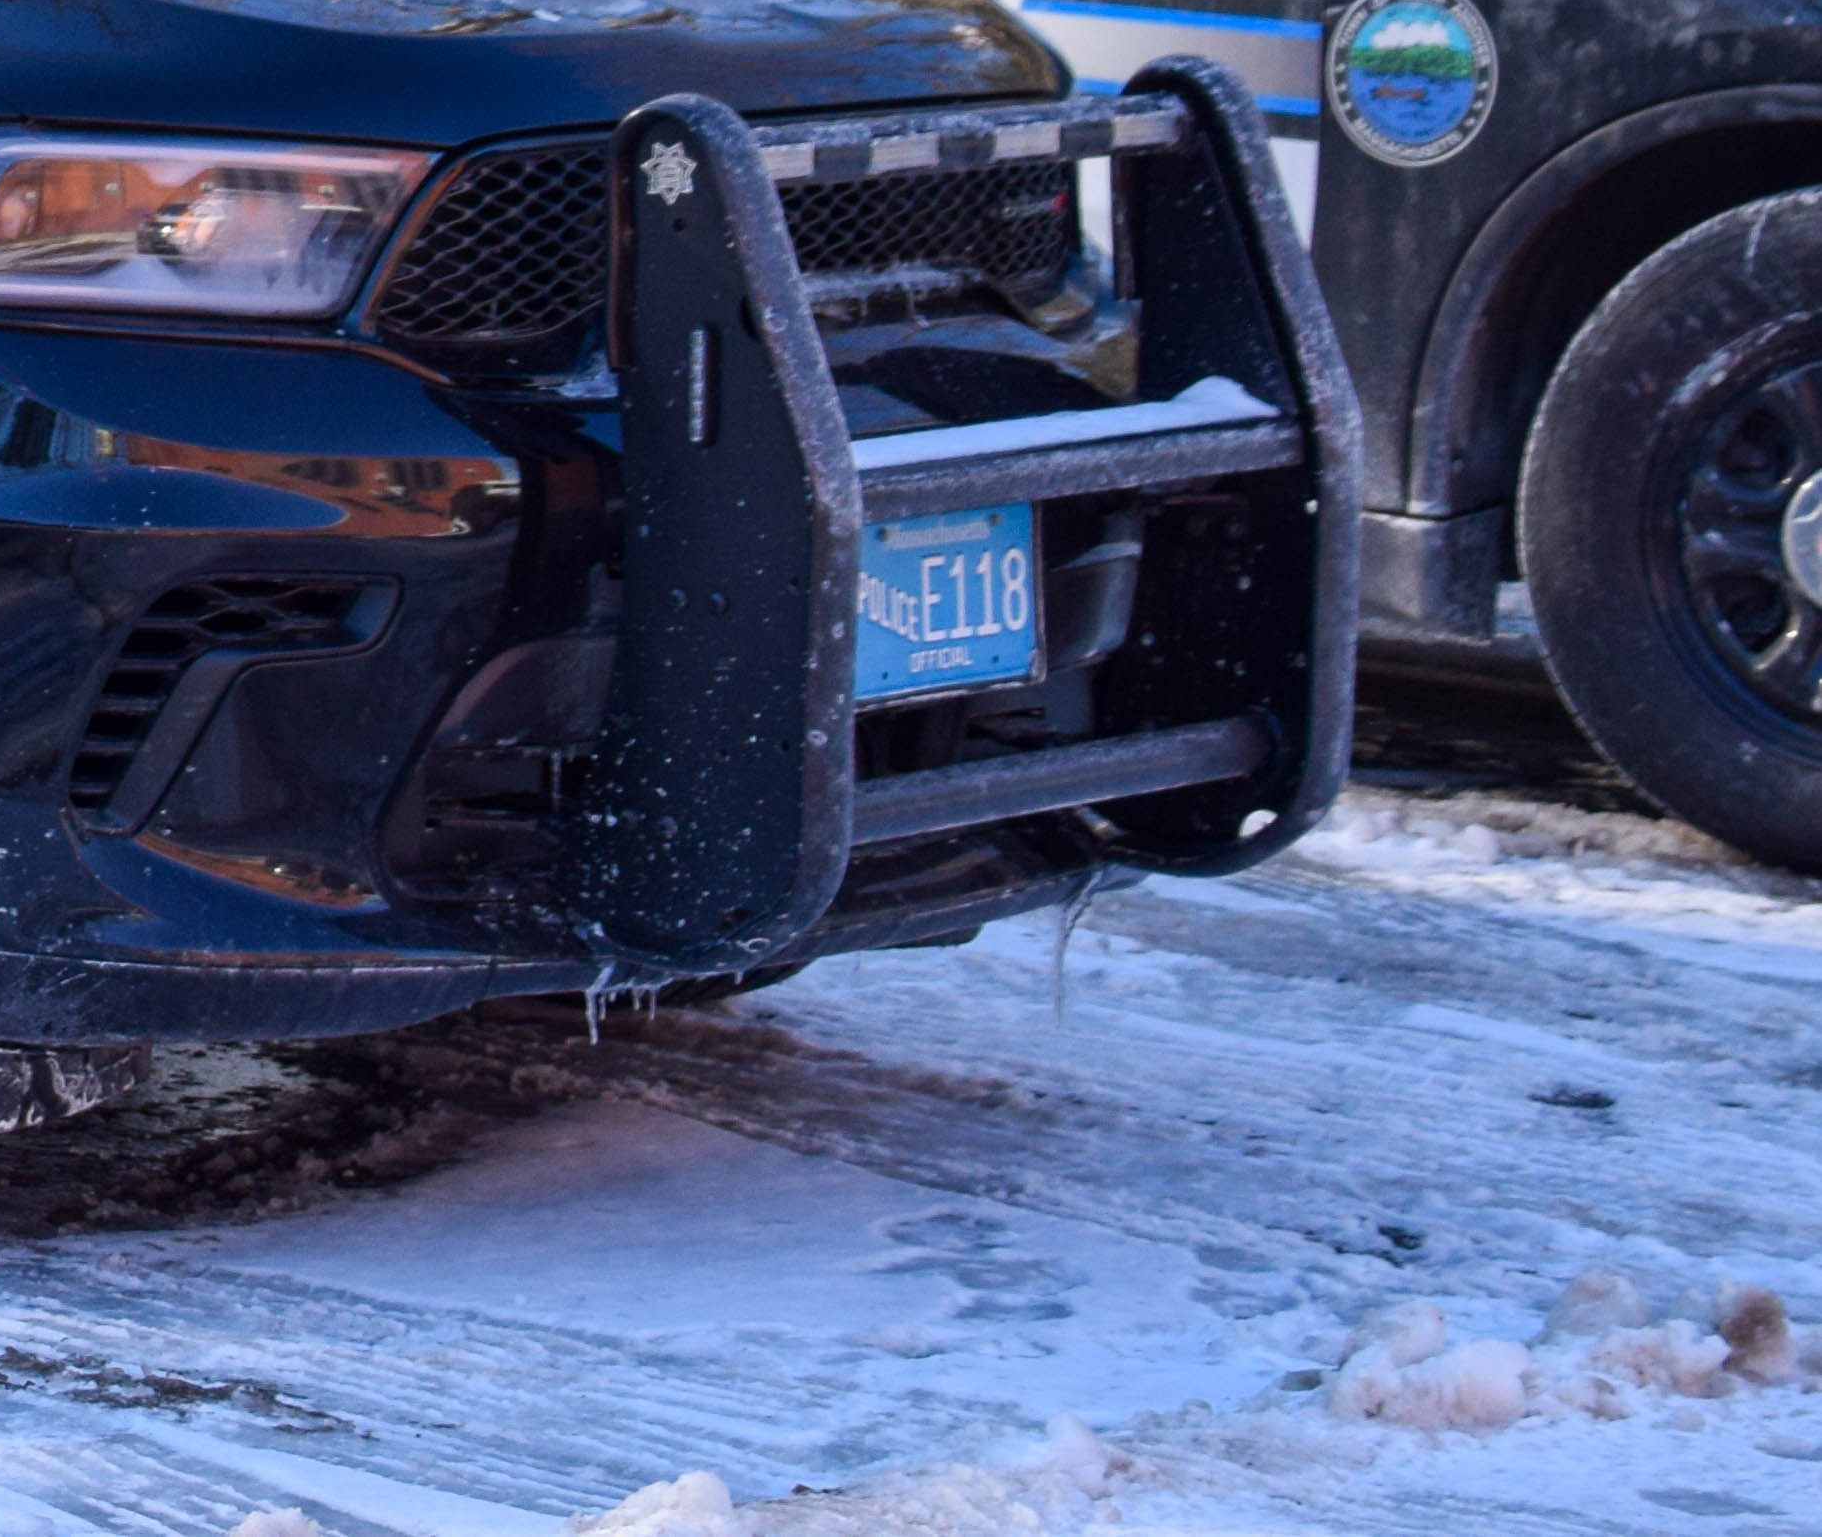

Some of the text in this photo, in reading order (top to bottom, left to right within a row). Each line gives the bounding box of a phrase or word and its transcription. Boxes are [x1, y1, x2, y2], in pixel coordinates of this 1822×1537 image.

[857, 547, 1029, 643] POLICE E118
[909, 646, 974, 673] OFFICIAL
